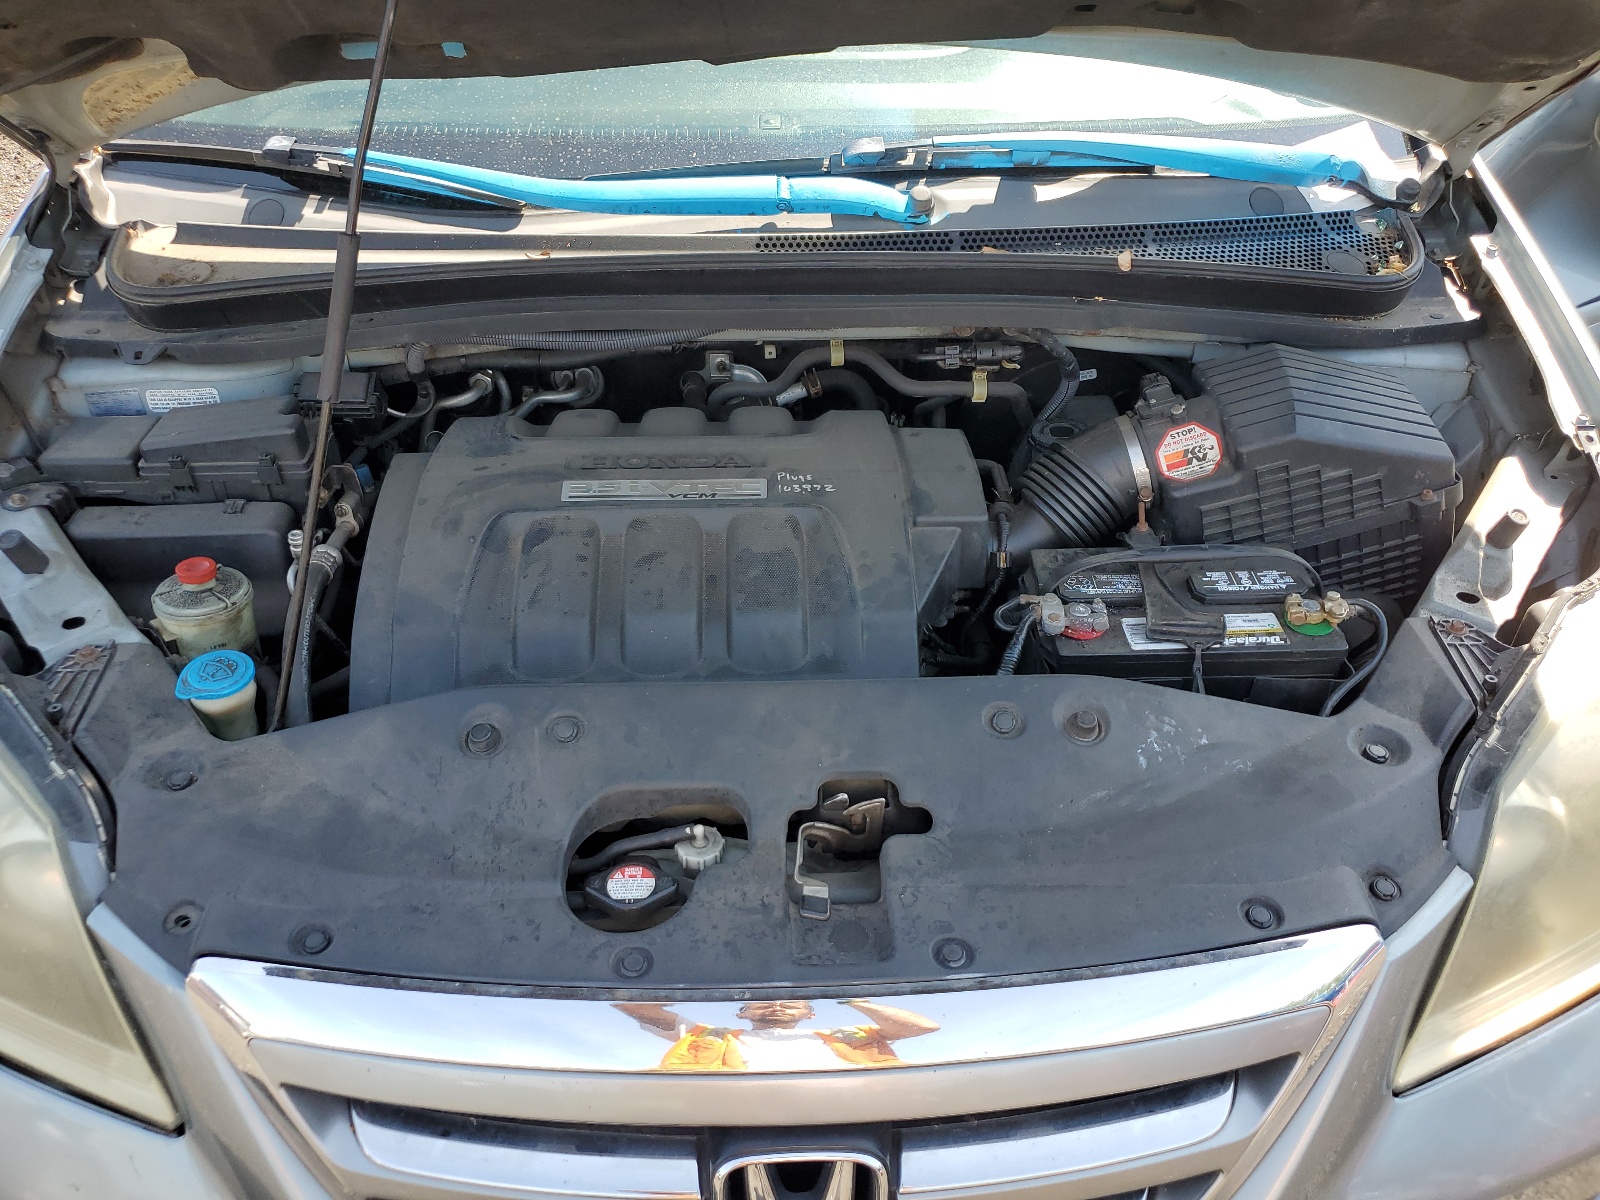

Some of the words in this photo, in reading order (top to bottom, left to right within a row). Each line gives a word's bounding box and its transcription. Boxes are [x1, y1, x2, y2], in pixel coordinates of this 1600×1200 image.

[1170, 427, 1196, 440] STOP!
[1183, 443, 1214, 466] K&N
[580, 454, 752, 470] HONDA
[777, 471, 813, 482] Plugs
[1223, 635, 1285, 647] Duralast
